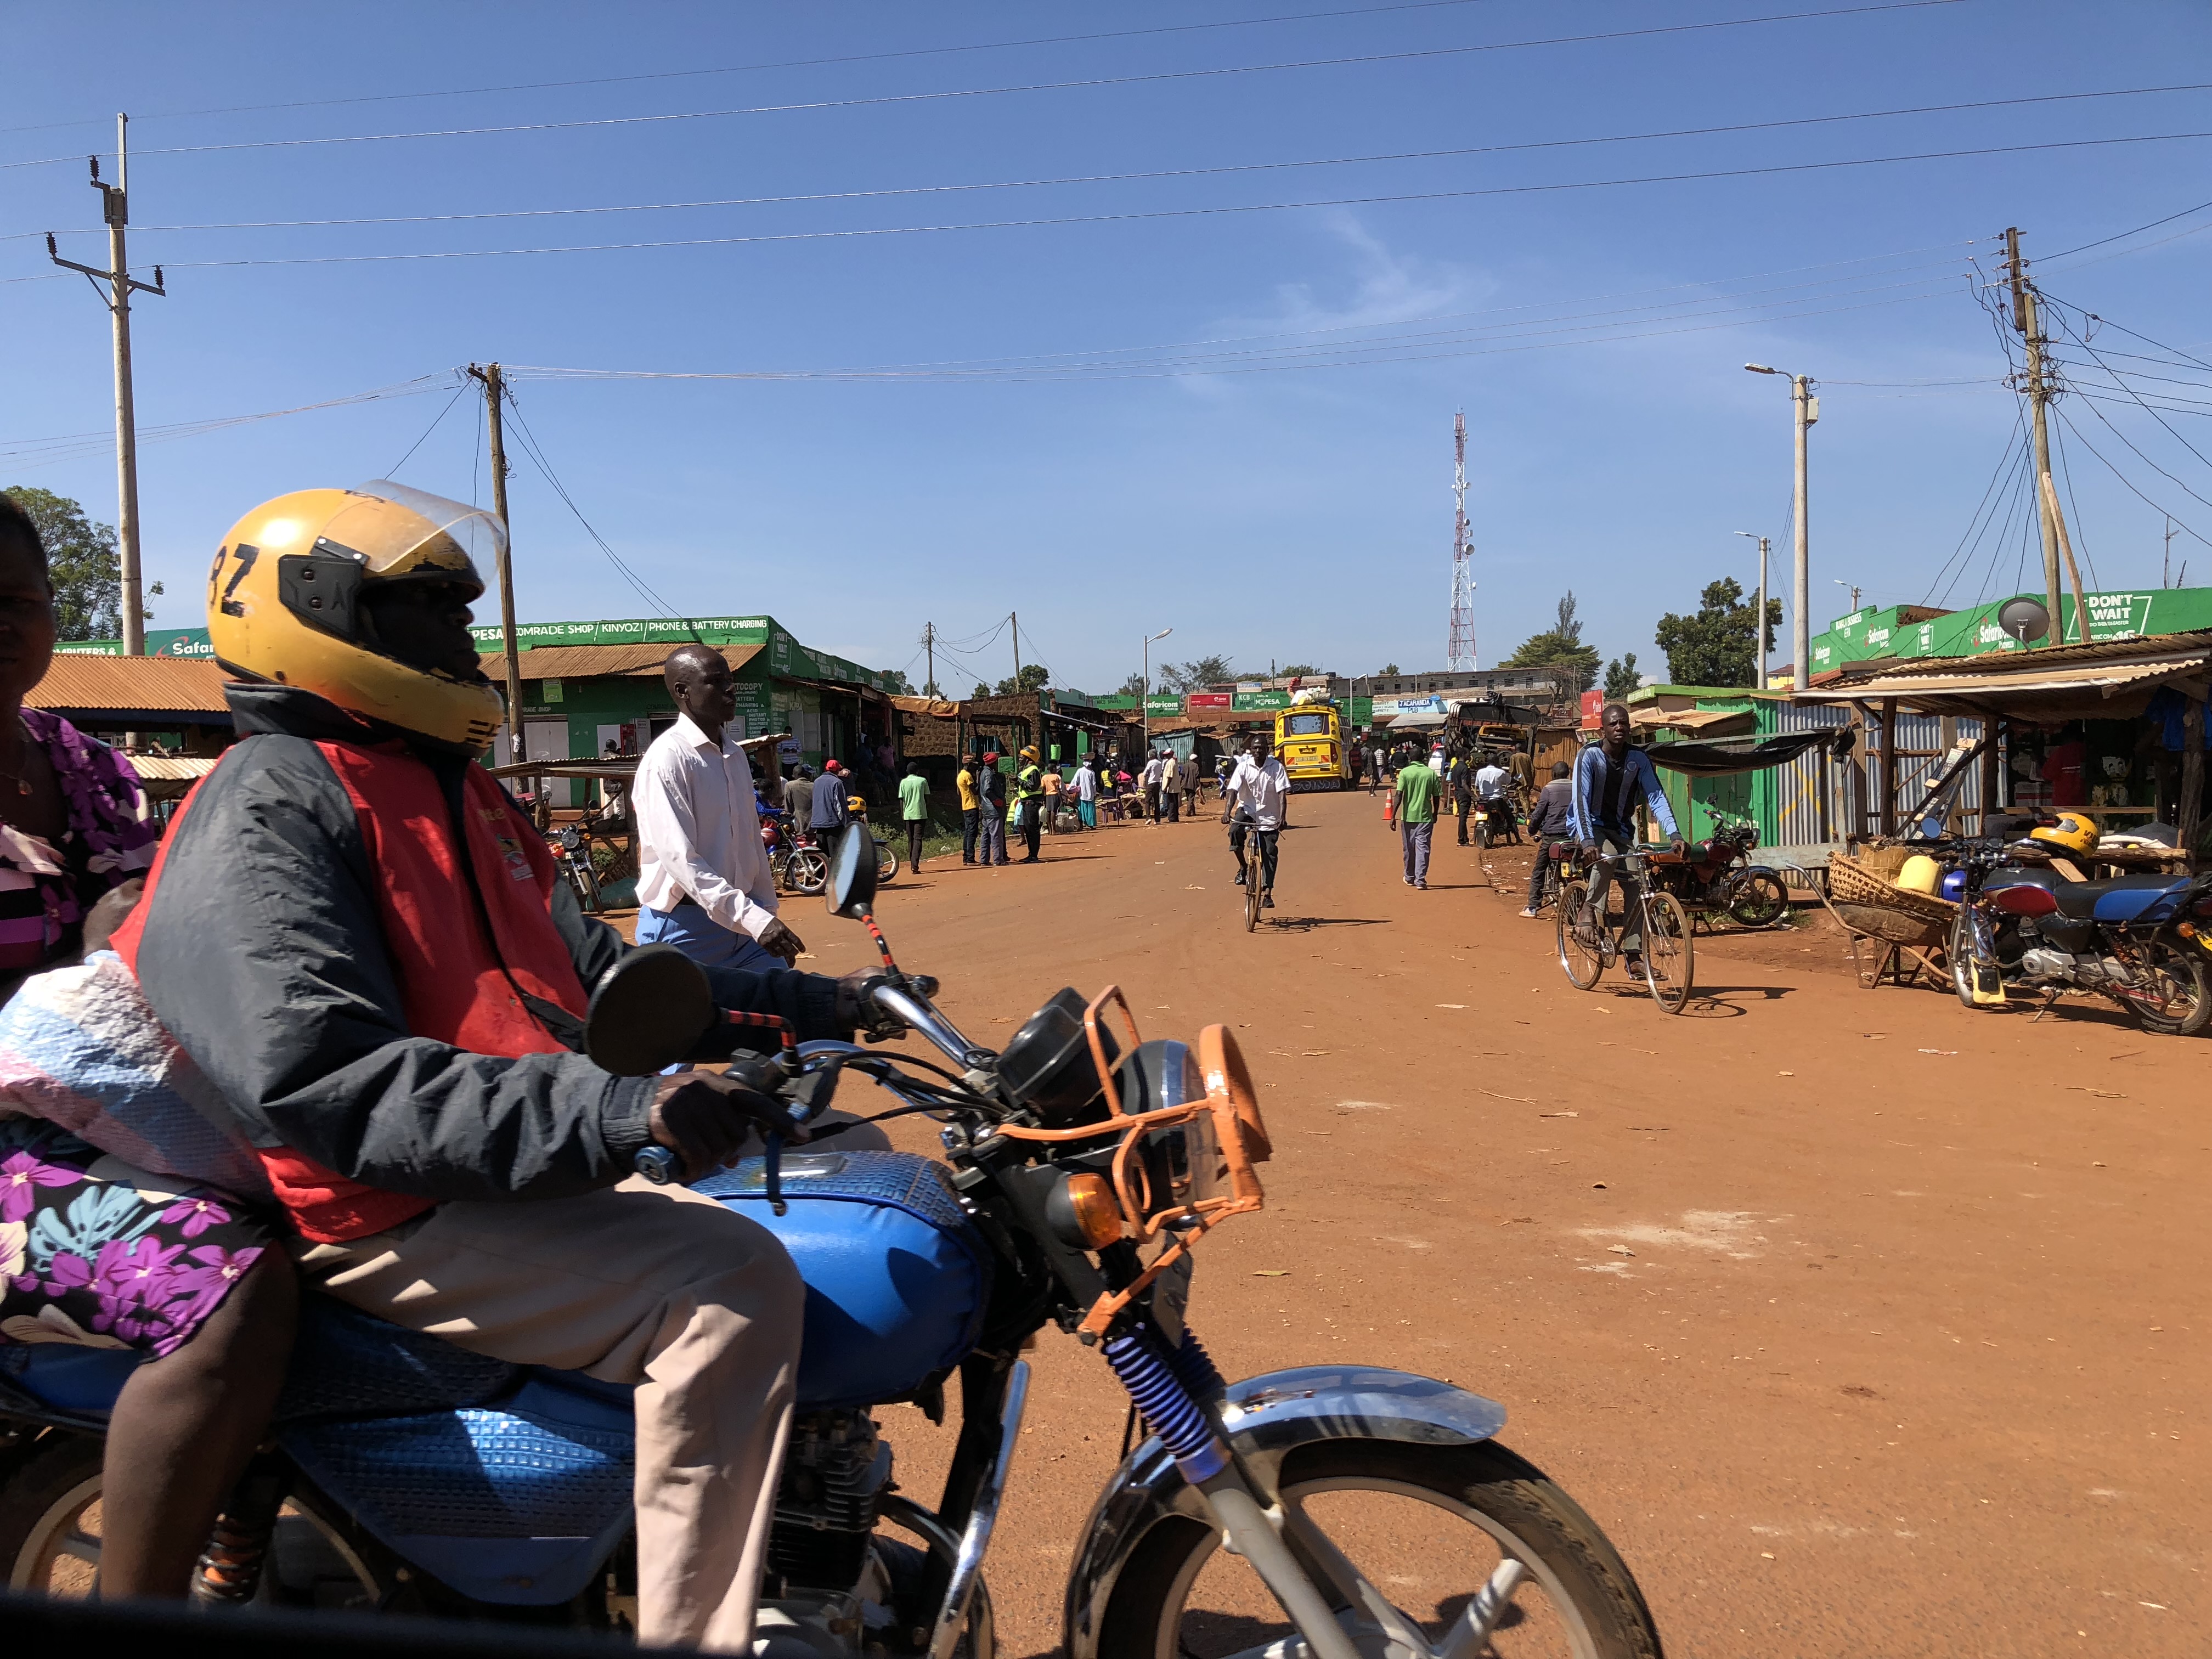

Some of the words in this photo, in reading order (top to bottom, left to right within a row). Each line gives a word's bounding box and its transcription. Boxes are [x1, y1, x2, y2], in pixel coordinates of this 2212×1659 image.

[2089, 594, 2133, 608] DON'T
[2091, 607, 2132, 620] WAIT
[568, 624, 594, 634] SHOP
[602, 623, 644, 633] KINYOZI
[649, 622, 681, 631] PHONE
[681, 621, 690, 630] &
[691, 620, 730, 630] BATTERY
[730, 619, 767, 629] CHARGING
[1868, 625, 1889, 645] Safaricom
[108, 647, 116, 656] &
